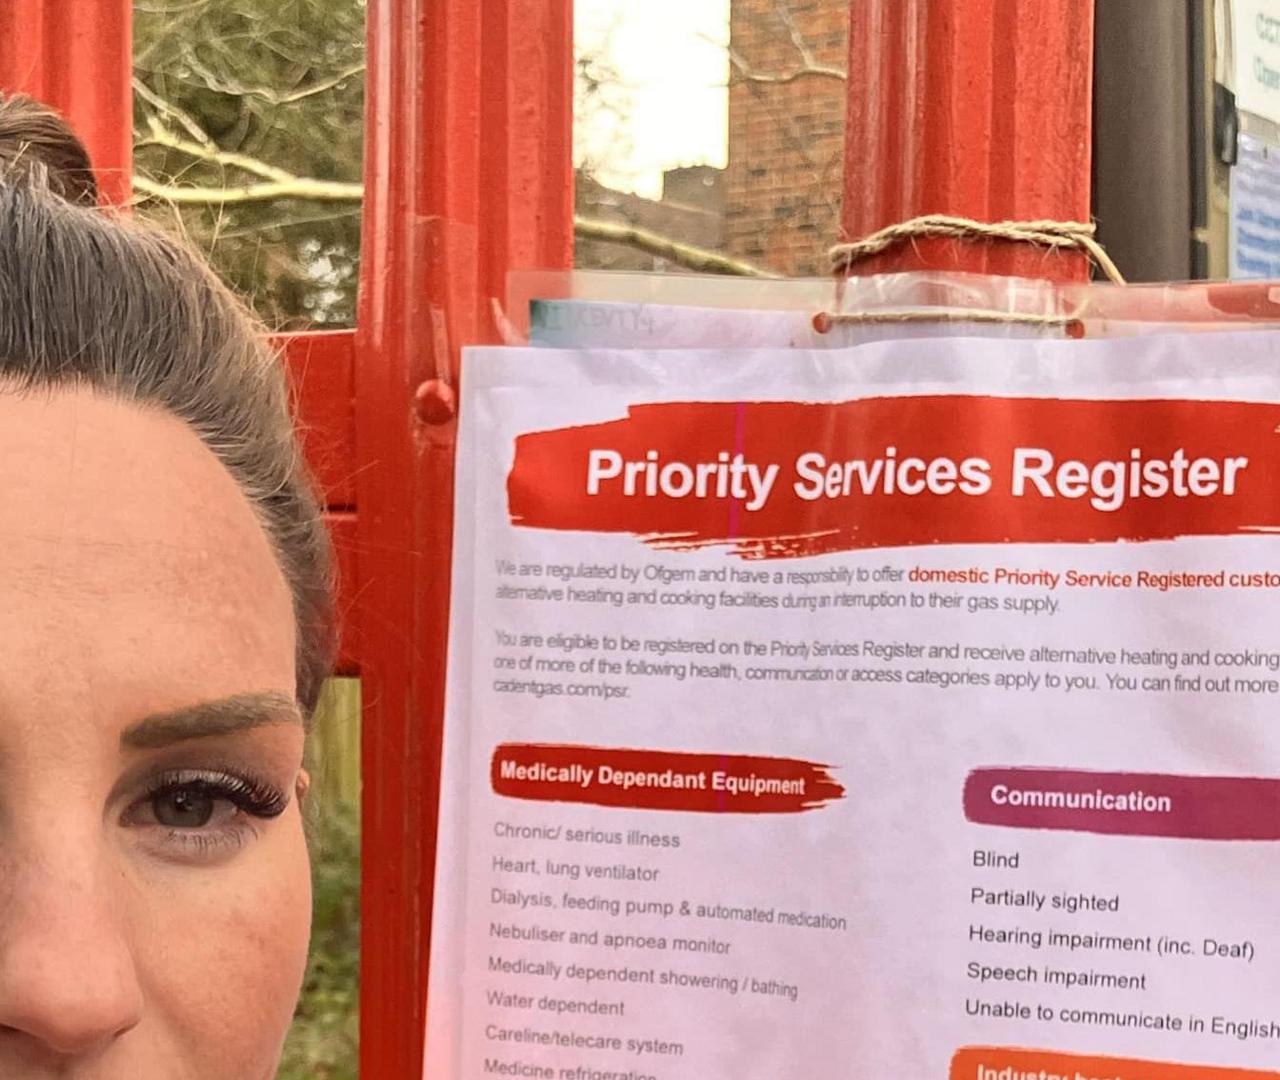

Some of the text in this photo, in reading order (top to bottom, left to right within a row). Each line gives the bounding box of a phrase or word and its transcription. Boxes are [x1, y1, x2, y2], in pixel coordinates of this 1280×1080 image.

[587, 447, 1248, 511] Priority Services Register
[519, 564, 542, 577] are
[547, 564, 617, 581] regulated
[621, 565, 639, 583] by
[644, 565, 695, 584] Ofgem
[698, 566, 726, 582] and
[731, 568, 770, 583] have
[872, 566, 904, 582] offer
[908, 567, 989, 584] domestic
[995, 568, 1060, 589] Priority
[1065, 571, 1132, 588] Service
[1137, 571, 1225, 591] Registered
[568, 587, 623, 606] heating
[627, 589, 656, 604] and
[660, 590, 715, 609] cooking
[720, 591, 778, 608] facilities
[910, 593, 924, 607] to
[929, 592, 962, 608] their
[968, 596, 999, 612] gas
[521, 634, 542, 647] are
[547, 633, 598, 651] eligible
[603, 636, 616, 650] to
[621, 636, 640, 651] be
[644, 639, 715, 656] registered
[719, 643, 739, 655] on
[744, 641, 767, 655] the
[771, 641, 810, 660] Priority
[813, 642, 858, 657] Services
[863, 641, 924, 661] Register
[928, 643, 959, 659] and
[964, 646, 1024, 661] receive
[1029, 647, 1115, 664] alternative
[1121, 649, 1177, 668] heating
[1181, 649, 1209, 666] and
[1214, 649, 1279, 670] cooking
[536, 659, 575, 672] more
[579, 658, 593, 673] of
[598, 660, 621, 674] the
[626, 660, 686, 680] following
[690, 662, 742, 681] health,
[851, 670, 902, 682] access
[906, 668, 989, 688] categories
[995, 672, 1040, 691] apply
[1045, 673, 1060, 688] to
[1064, 677, 1100, 692] you.
[1106, 673, 1137, 690] You
[1141, 678, 1170, 691] can
[1174, 675, 1200, 692] find
[1205, 677, 1230, 692] out
[1235, 679, 1279, 693] more
[500, 760, 806, 797] Medically Dependant Equipment
[991, 785, 1172, 813] Communication
[493, 821, 680, 848] Chronic/ serious illness
[492, 857, 659, 882] Heart, lung ventilator
[973, 850, 1020, 869] Blind
[490, 888, 847, 931] Dialysis, feeding pump & automated medication
[971, 888, 1120, 914] Partially sighted
[489, 923, 731, 955] Nebuliser and apnoea monitor
[969, 925, 1255, 962] Hearing impairment (inc. Deaf)
[487, 956, 798, 1002] Medically dependent showering bathing
[967, 962, 1146, 990] Speech impairment
[486, 990, 625, 1017] Water dependent
[965, 999, 1280, 1041] Unable to communicate in English
[484, 1025, 684, 1057] Careline/telecare system
[483, 1058, 554, 1080] Medicine
